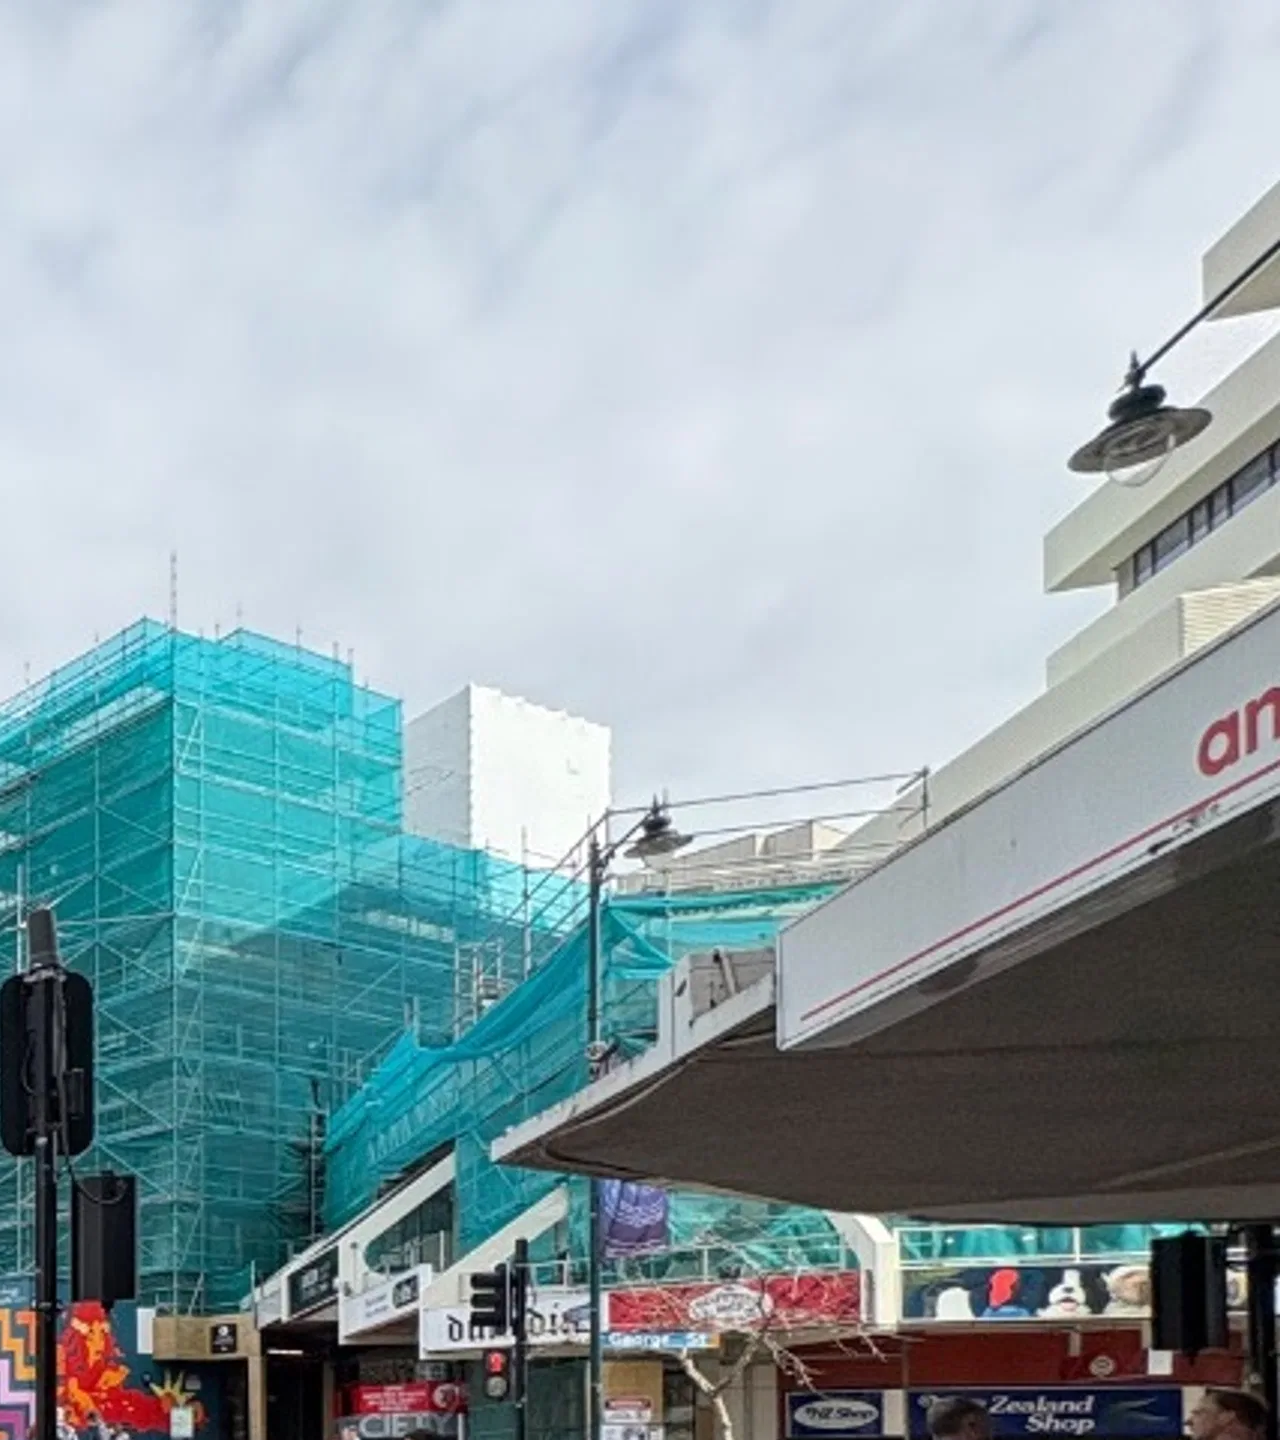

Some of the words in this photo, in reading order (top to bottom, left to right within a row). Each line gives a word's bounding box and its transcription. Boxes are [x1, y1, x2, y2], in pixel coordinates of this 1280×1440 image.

[608, 1331, 669, 1348] George
[685, 1331, 706, 1347] St
[989, 1394, 1095, 1414] Zealand
[835, 1407, 873, 1420] Shop
[1025, 1413, 1096, 1435] Shop
